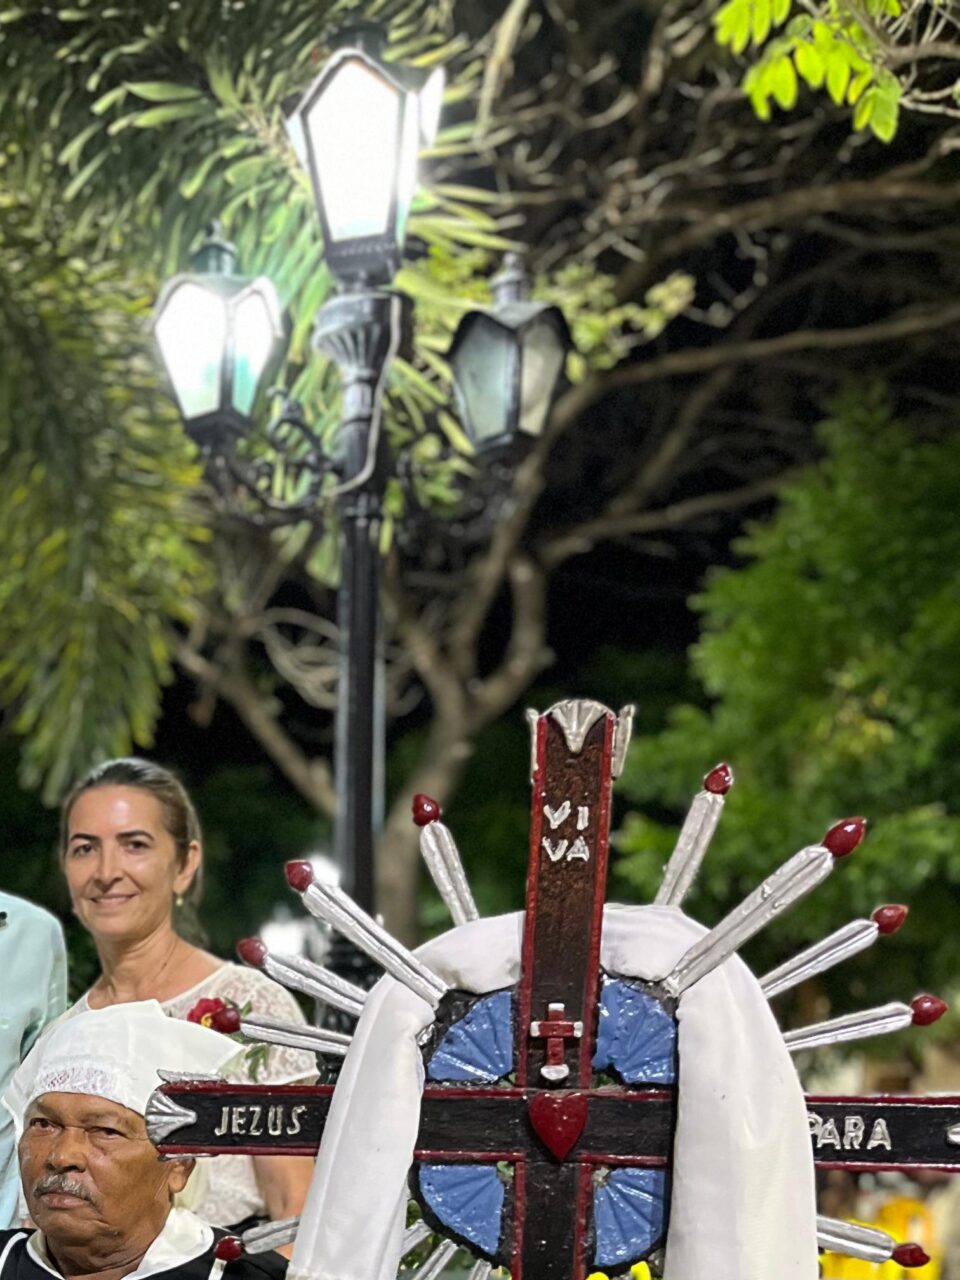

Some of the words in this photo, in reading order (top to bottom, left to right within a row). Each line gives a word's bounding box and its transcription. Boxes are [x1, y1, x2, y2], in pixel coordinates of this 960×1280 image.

[543, 800, 589, 831] VI
[542, 836, 590, 862] VA
[214, 1104, 308, 1136] JEZUS
[807, 1111, 891, 1150] PARA
